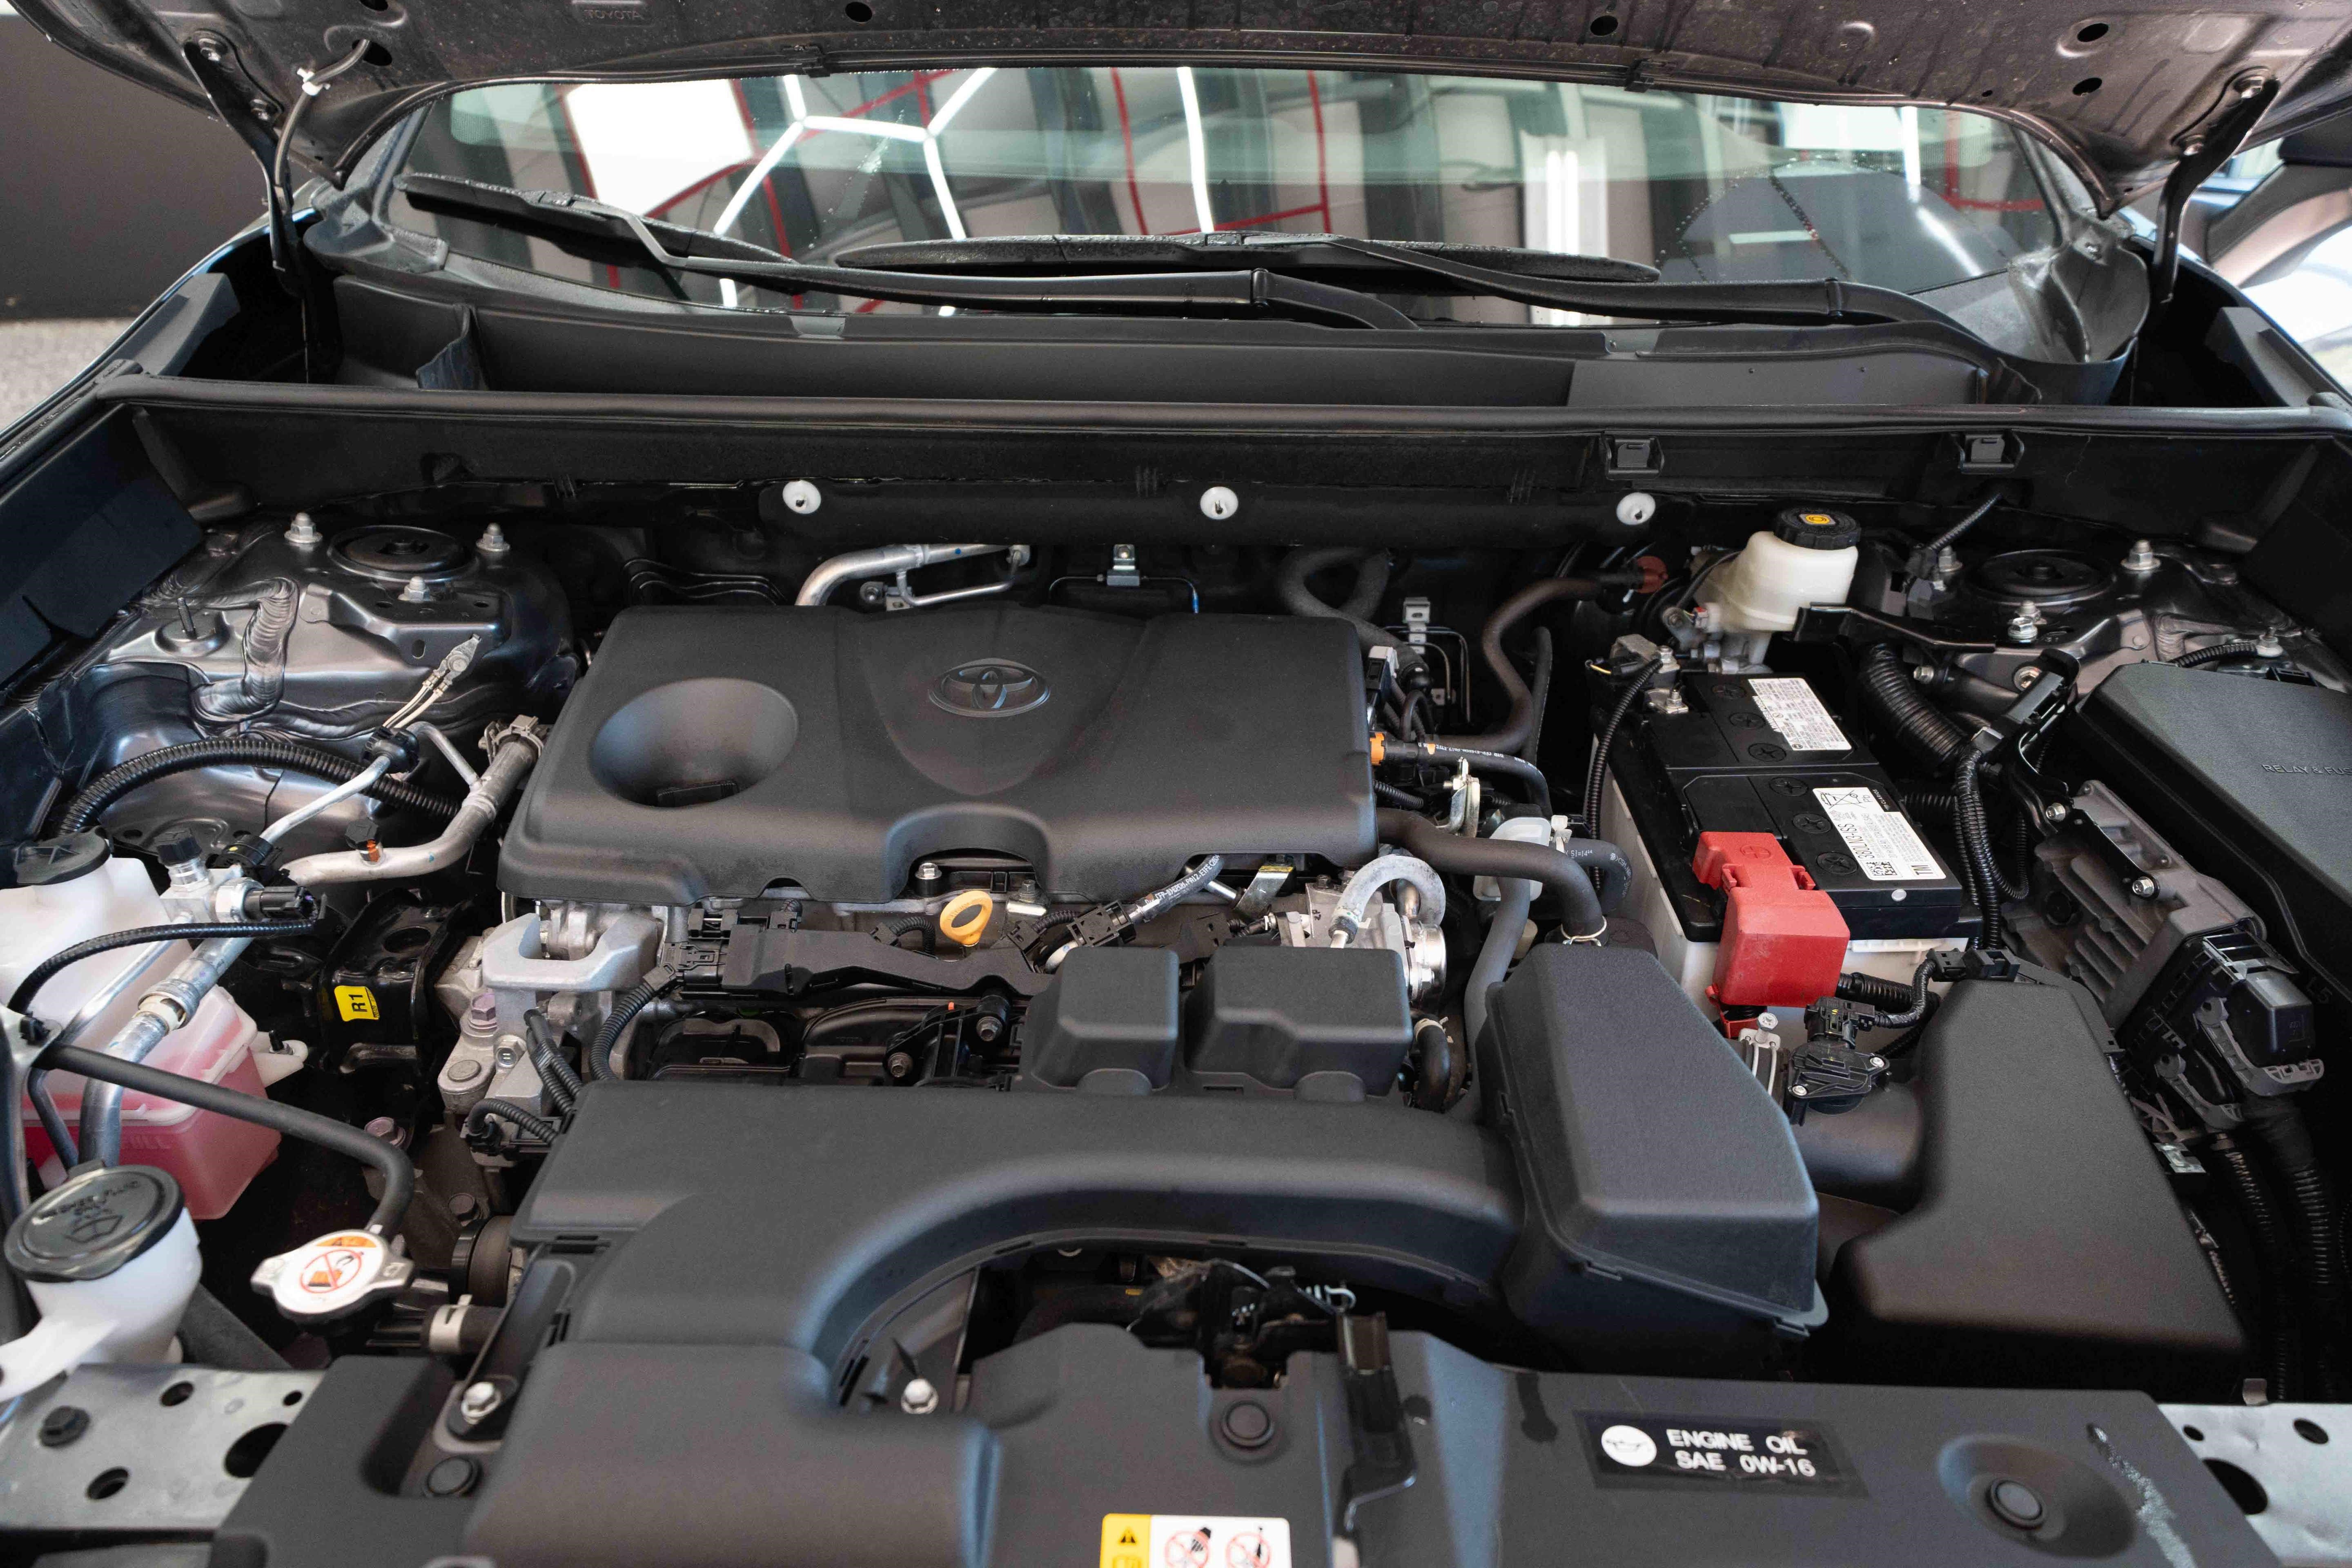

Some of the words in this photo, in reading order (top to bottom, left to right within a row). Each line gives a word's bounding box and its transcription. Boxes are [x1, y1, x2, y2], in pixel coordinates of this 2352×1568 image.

[584, 9, 644, 20] TOYOTA
[2261, 764, 2309, 774] RELAY
[1862, 795, 1873, 803] Pb
[1873, 789, 1886, 804] CLARIOS
[1838, 823, 1875, 859] 380LN3-ISS
[1911, 864, 1933, 875] TM
[348, 994, 368, 1012] R1
[1666, 1428, 1755, 1452] ENGINE
[1765, 1435, 1808, 1455] OIL
[1675, 1450, 1727, 1471] SAE
[1739, 1454, 1817, 1477] 0W-16
